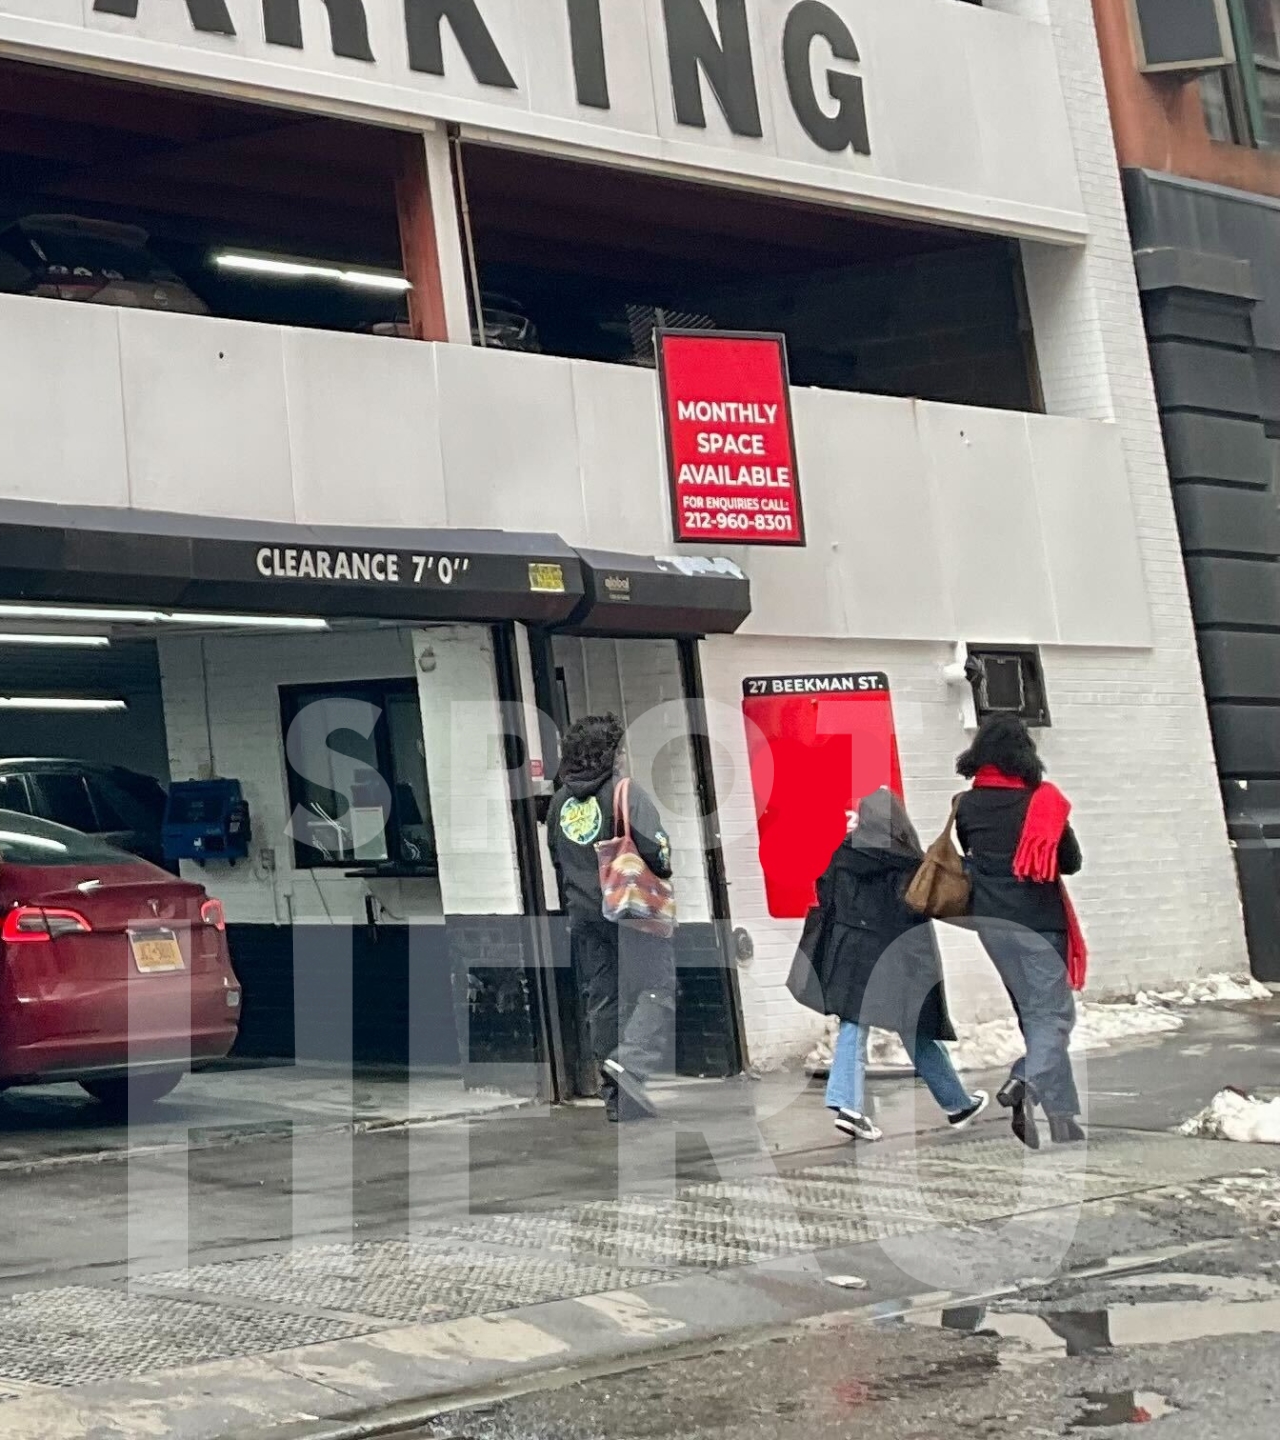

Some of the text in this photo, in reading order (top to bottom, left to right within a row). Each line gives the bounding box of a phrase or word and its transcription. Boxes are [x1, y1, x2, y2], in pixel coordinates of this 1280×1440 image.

[677, 400, 778, 424] MONTHLY
[696, 432, 766, 455] SPACE
[677, 463, 791, 488] AVAILABLE
[682, 495, 789, 513] FOR ENQUIRIES CALL:
[684, 512, 792, 531] 212-960-8301
[255, 547, 400, 582] CLEARANCE
[748, 675, 883, 694] 27 BEEKMAN ST.
